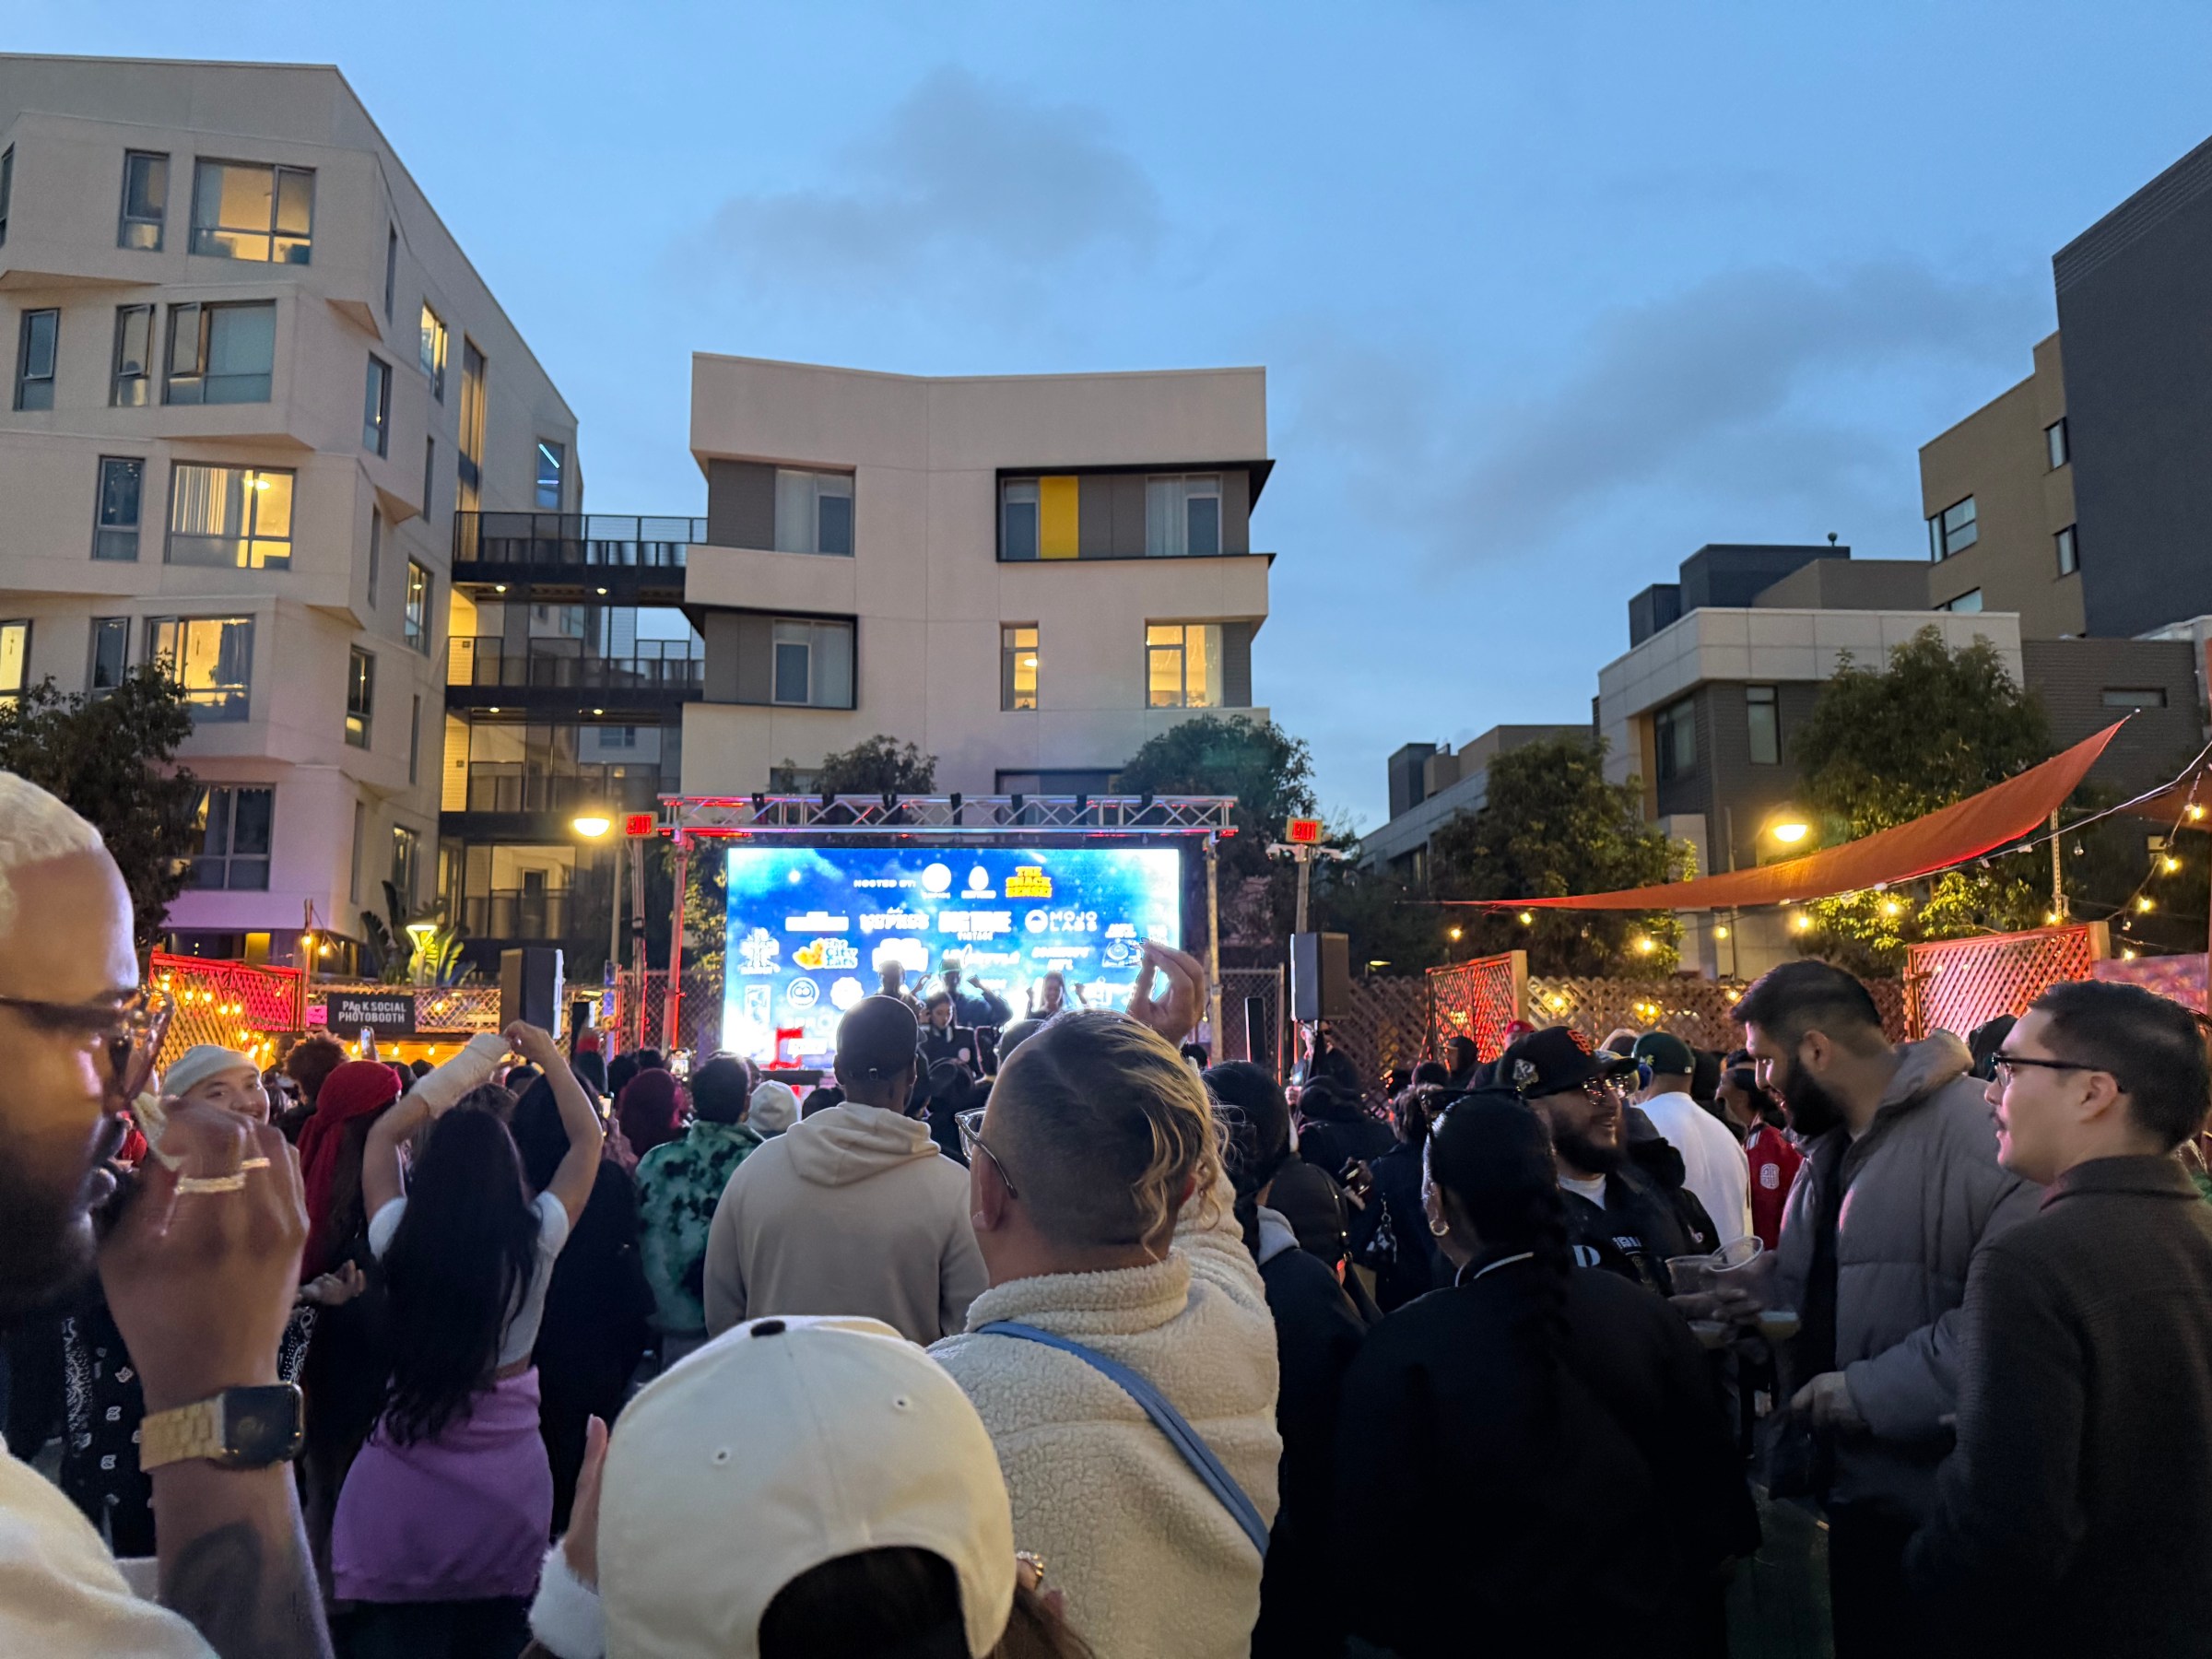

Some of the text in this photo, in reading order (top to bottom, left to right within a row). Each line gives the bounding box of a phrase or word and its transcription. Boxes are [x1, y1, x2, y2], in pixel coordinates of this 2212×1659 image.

[1293, 820, 1317, 841] EXIT
[853, 879, 897, 888] HOSTED
[1050, 911, 1097, 922] MOJO
[1050, 921, 1097, 932] LABS
[371, 1001, 406, 1012] SOCIAL
[338, 1012, 405, 1022] PHOTOBOOTH
